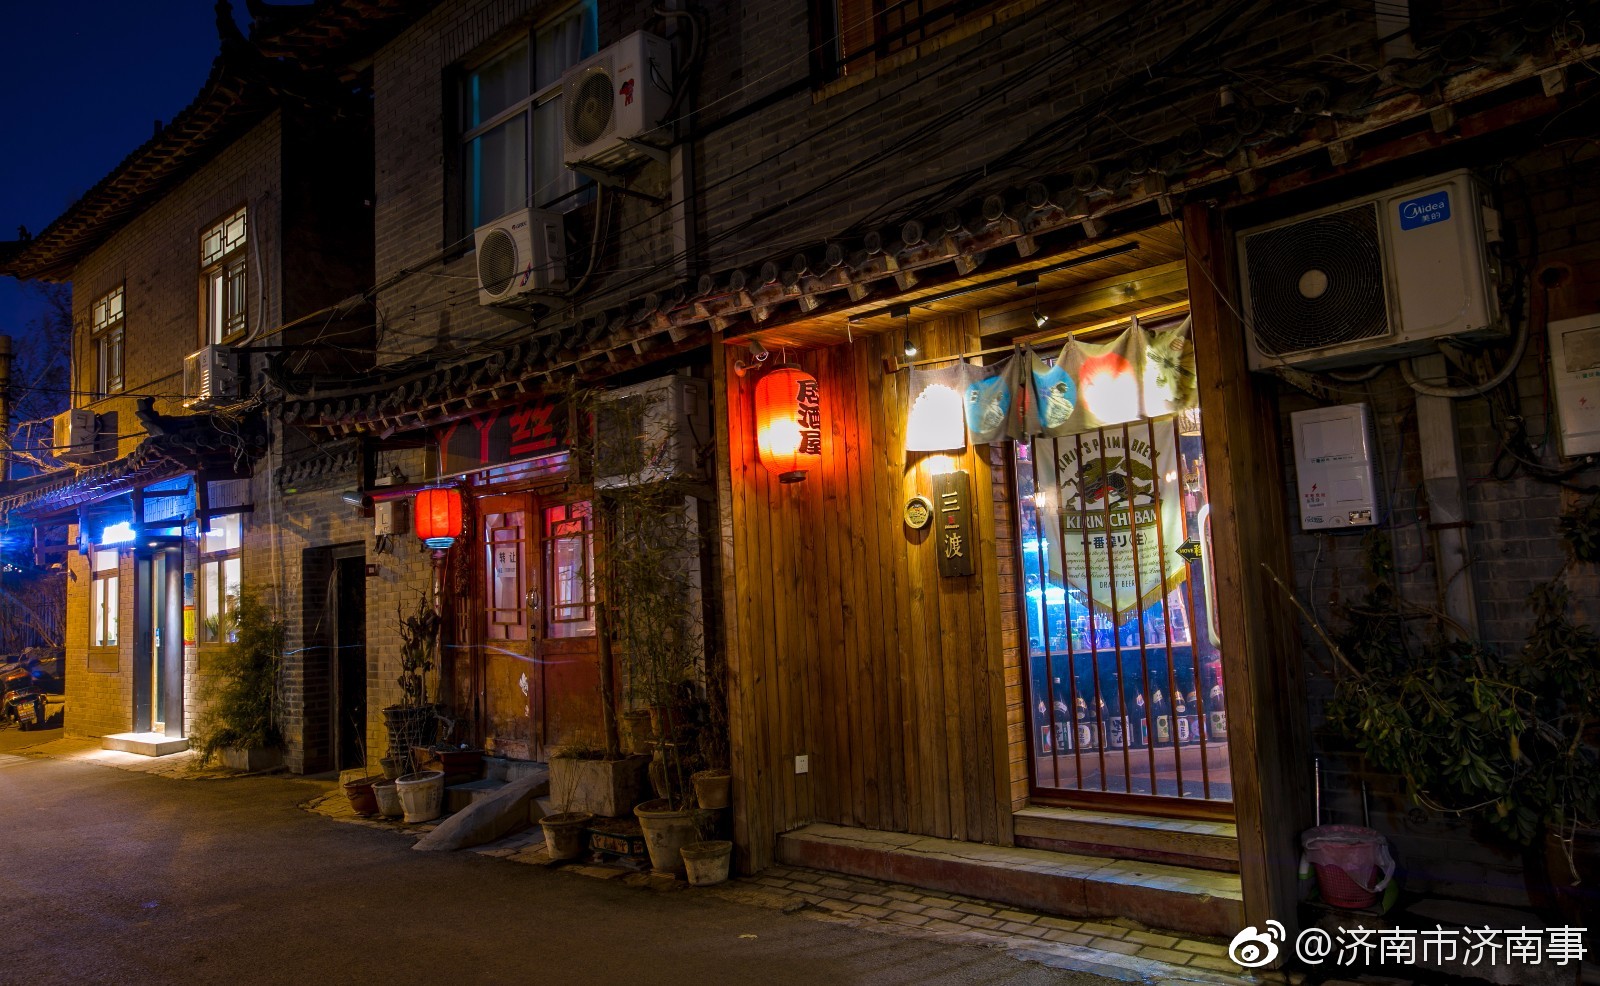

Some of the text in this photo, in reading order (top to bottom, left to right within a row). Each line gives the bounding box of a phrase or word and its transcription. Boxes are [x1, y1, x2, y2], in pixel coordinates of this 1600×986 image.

[1408, 201, 1445, 217] Midea
[1066, 515, 1104, 529] KIRIN
[499, 551, 516, 564] 转让
[1100, 581, 1118, 589] DRAT
